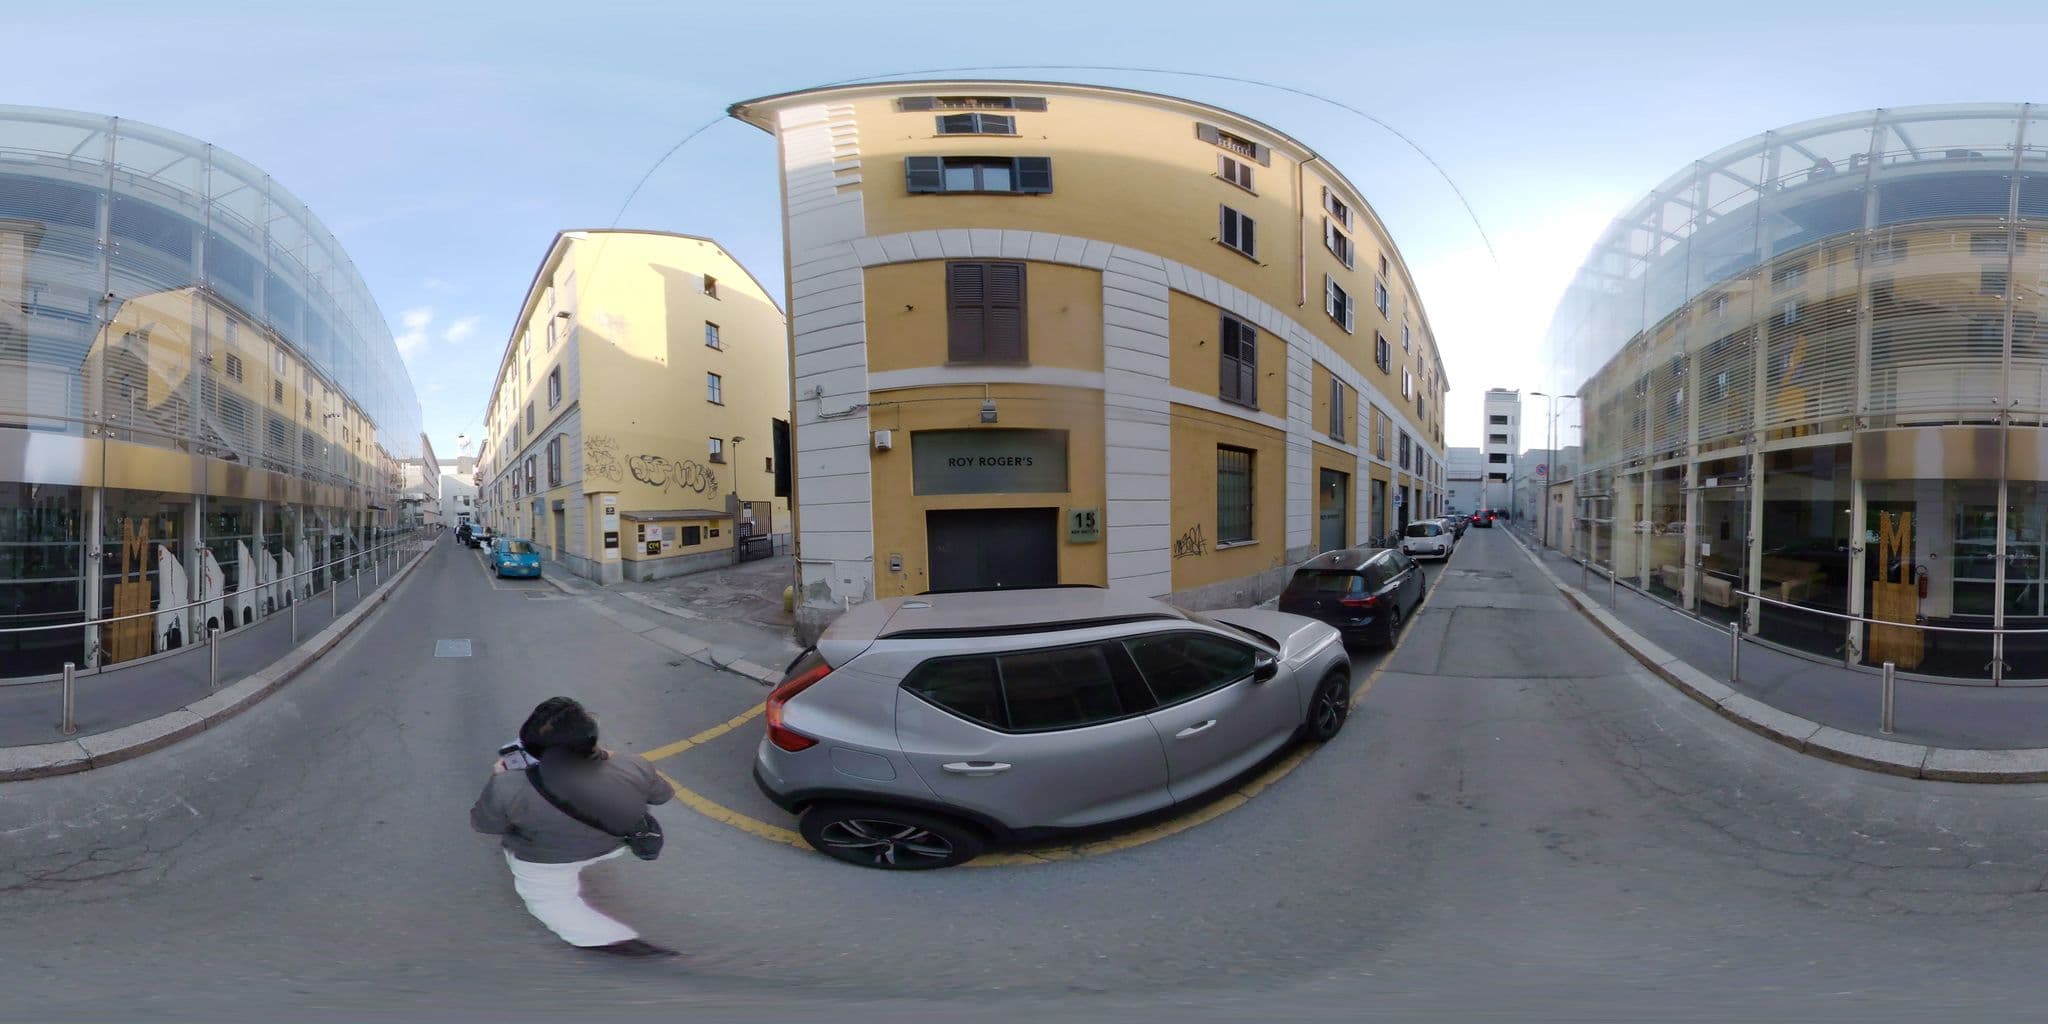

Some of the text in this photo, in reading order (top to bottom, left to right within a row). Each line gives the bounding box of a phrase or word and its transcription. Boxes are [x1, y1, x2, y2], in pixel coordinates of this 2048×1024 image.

[948, 456, 1033, 467] ROY ROGER'S
[1075, 512, 1095, 529] 15
